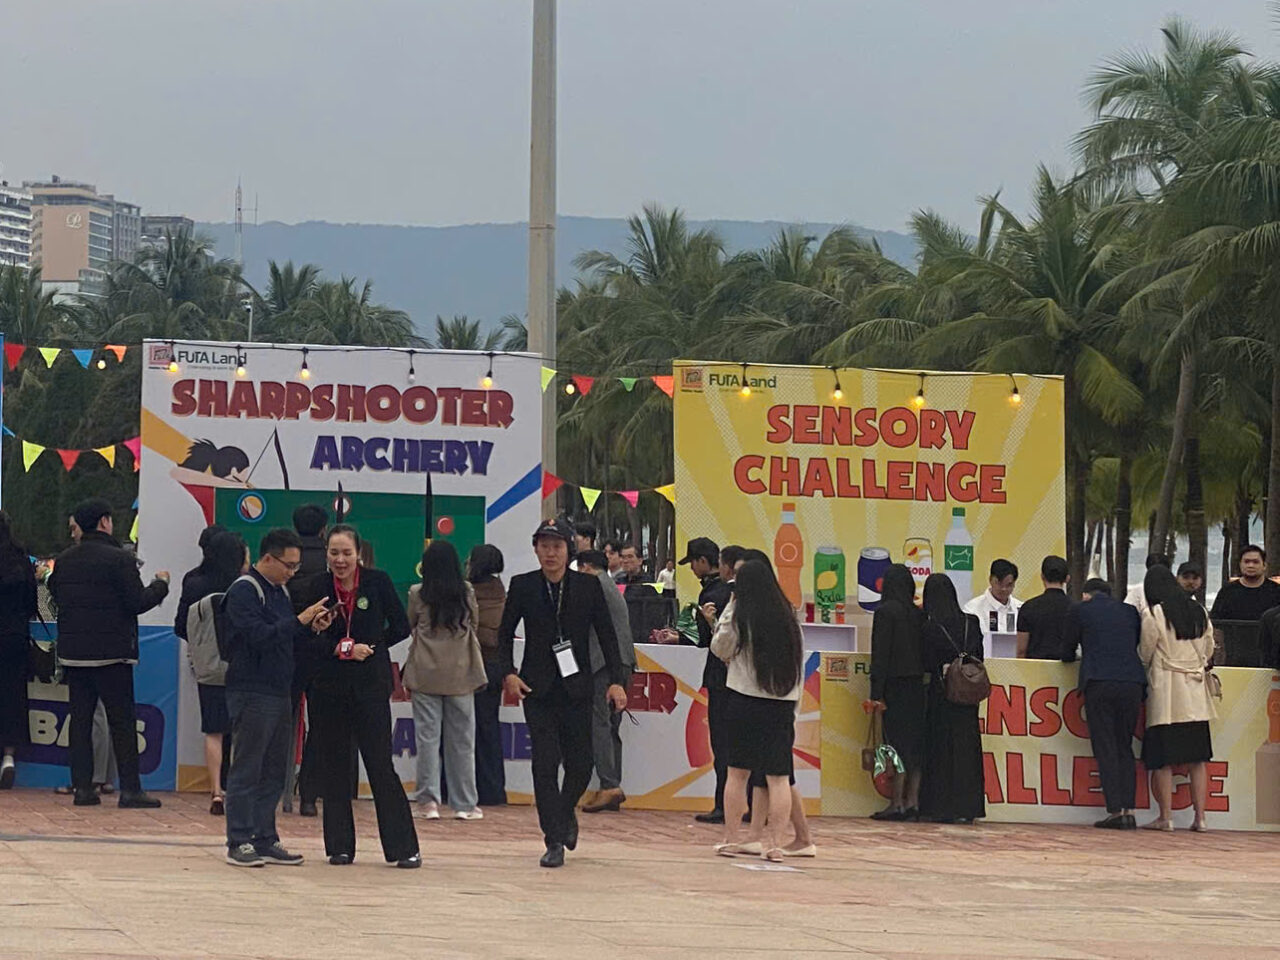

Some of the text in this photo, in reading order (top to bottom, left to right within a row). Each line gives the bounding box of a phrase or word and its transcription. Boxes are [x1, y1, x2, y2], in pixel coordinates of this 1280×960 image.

[178, 350, 247, 365] FUTA Land
[709, 373, 740, 387] FUTA
[750, 376, 777, 388] and
[171, 378, 515, 429] SHARPSHOOTER
[766, 404, 976, 451] SENSORY
[309, 435, 494, 476] ARCHERY
[733, 454, 1007, 504] CHALLENGE
